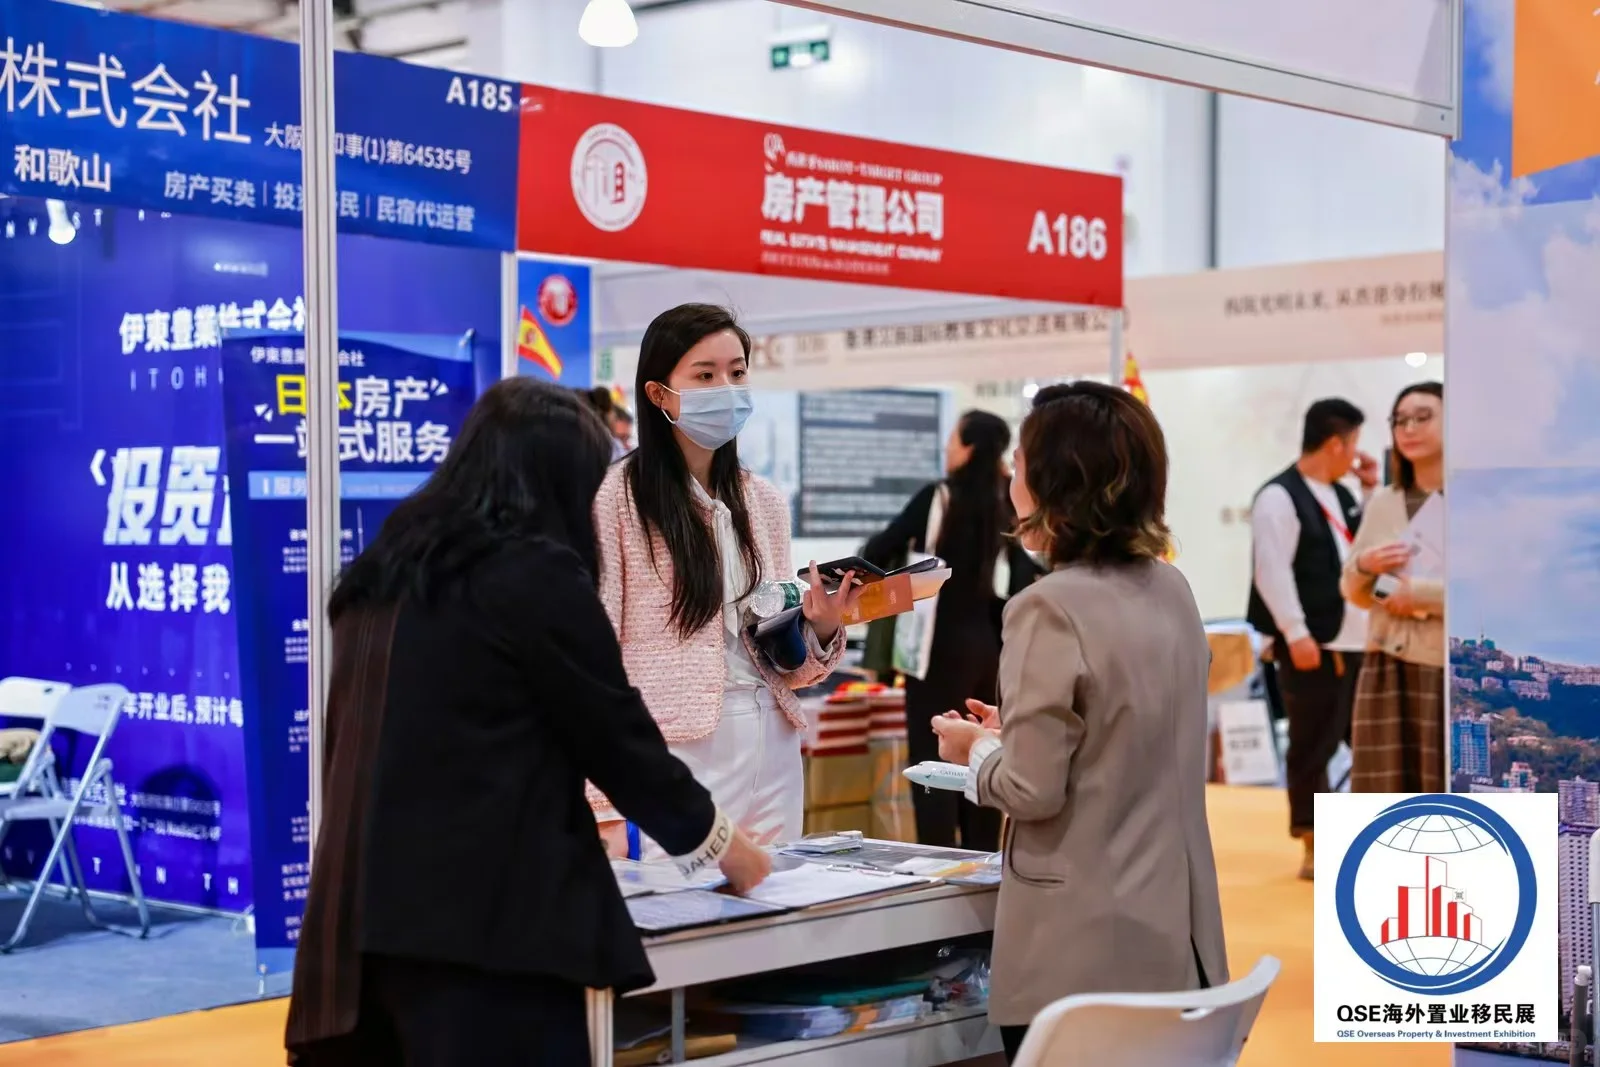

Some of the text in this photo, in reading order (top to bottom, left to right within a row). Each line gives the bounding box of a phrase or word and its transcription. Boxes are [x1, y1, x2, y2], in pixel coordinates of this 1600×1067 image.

[0, 36, 252, 145] 株式会社
[445, 75, 513, 113] A185
[14, 144, 112, 192] 和歌山
[164, 171, 256, 208] 房产买卖
[377, 195, 475, 232] 民宿代运营
[761, 172, 944, 240] 房产管理公司
[1027, 209, 1107, 260] A186
[106, 562, 231, 615] 从选择我
